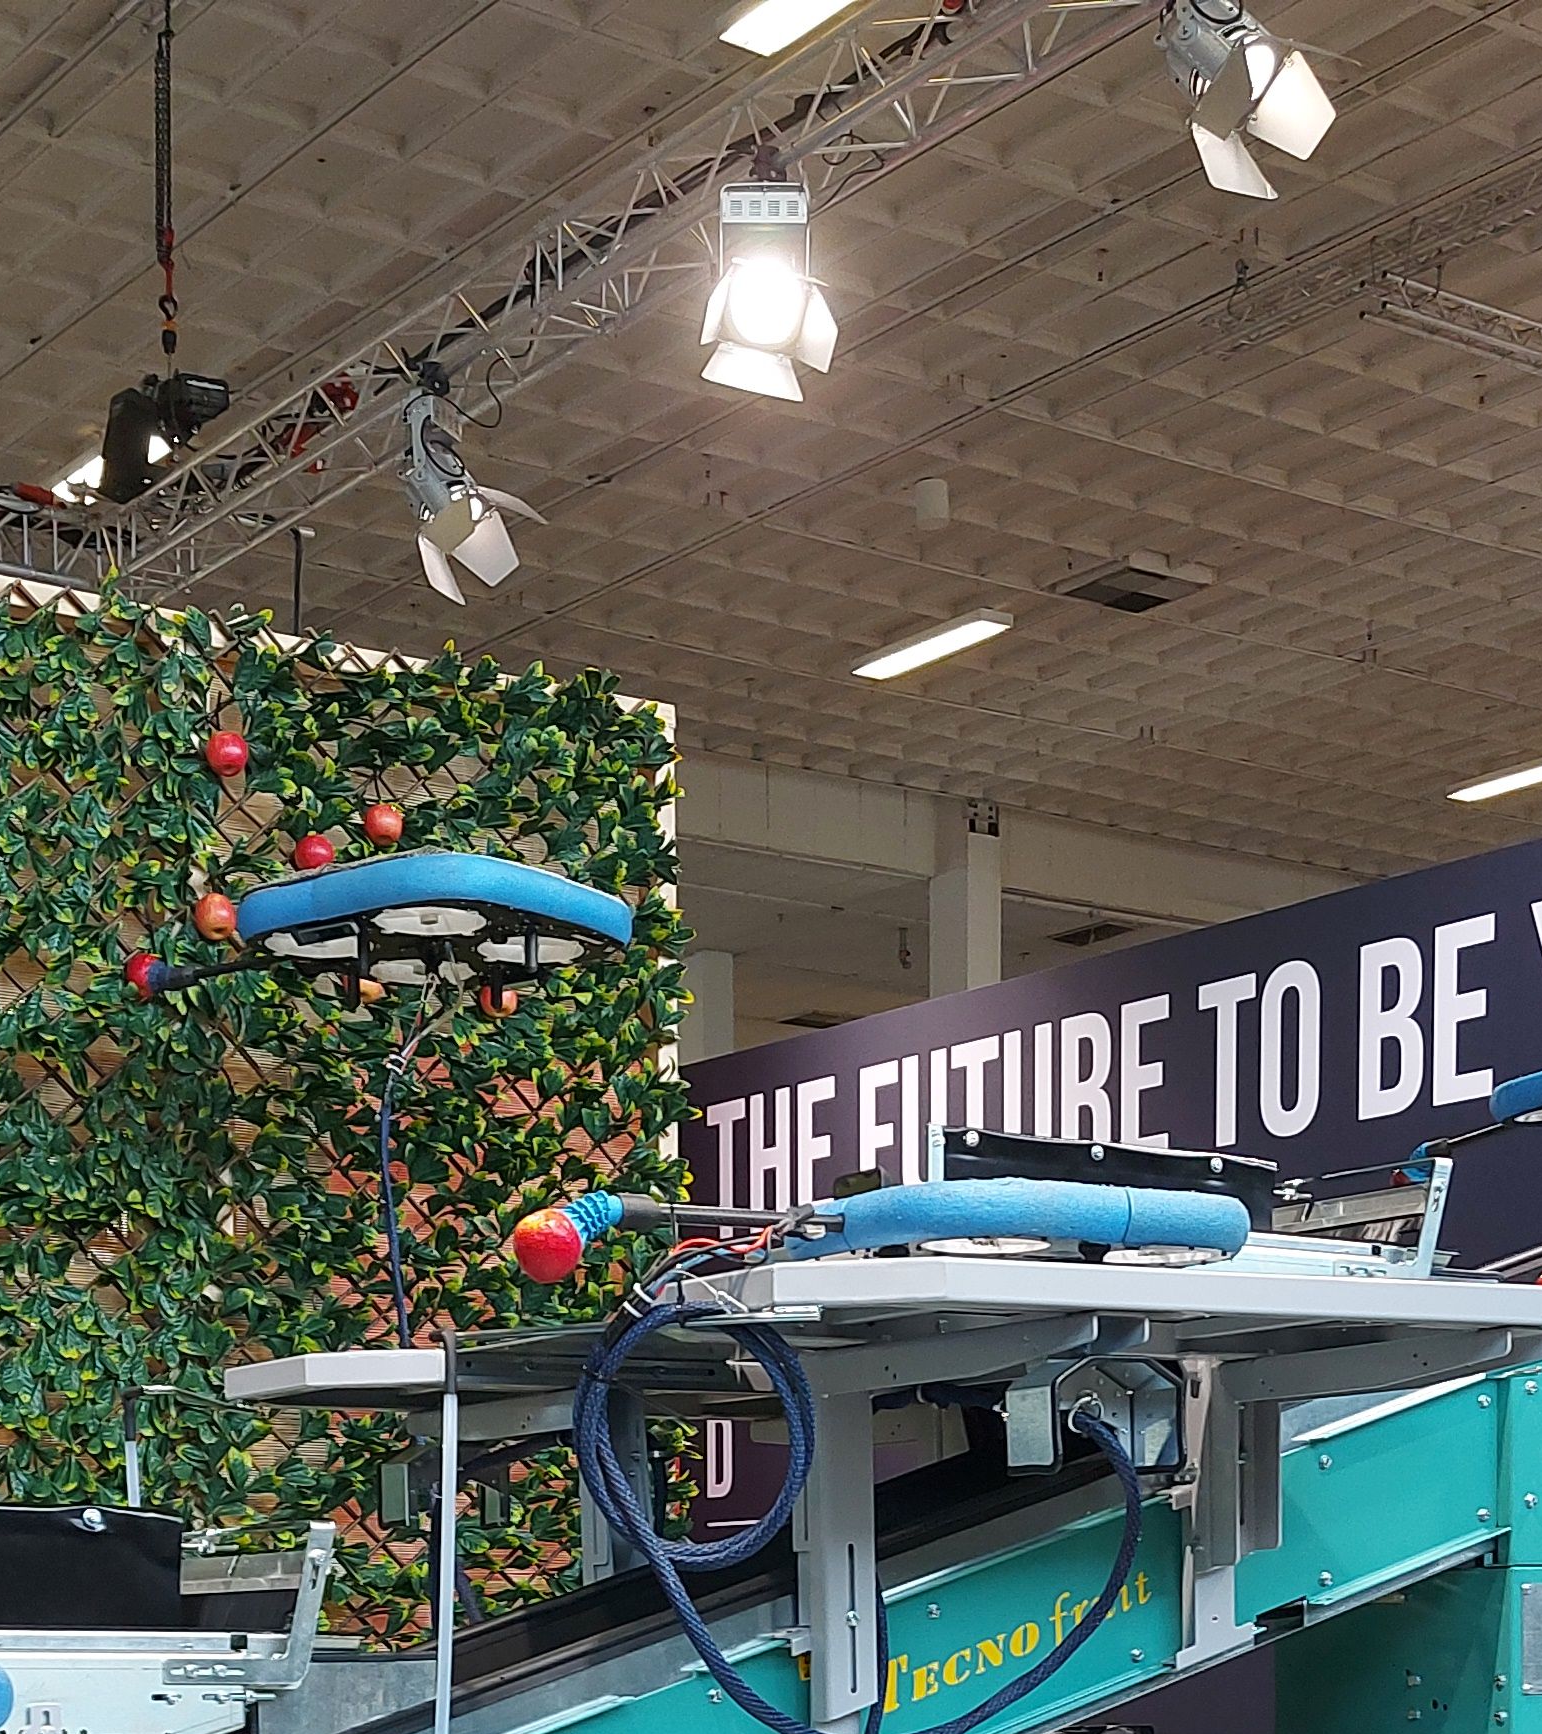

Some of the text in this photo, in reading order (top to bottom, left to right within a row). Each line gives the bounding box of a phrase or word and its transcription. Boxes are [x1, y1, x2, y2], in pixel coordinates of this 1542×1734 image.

[705, 1074, 837, 1240] THE
[858, 995, 1170, 1185] FUTURE
[1197, 959, 1322, 1147] TO
[1357, 912, 1497, 1122] BE
